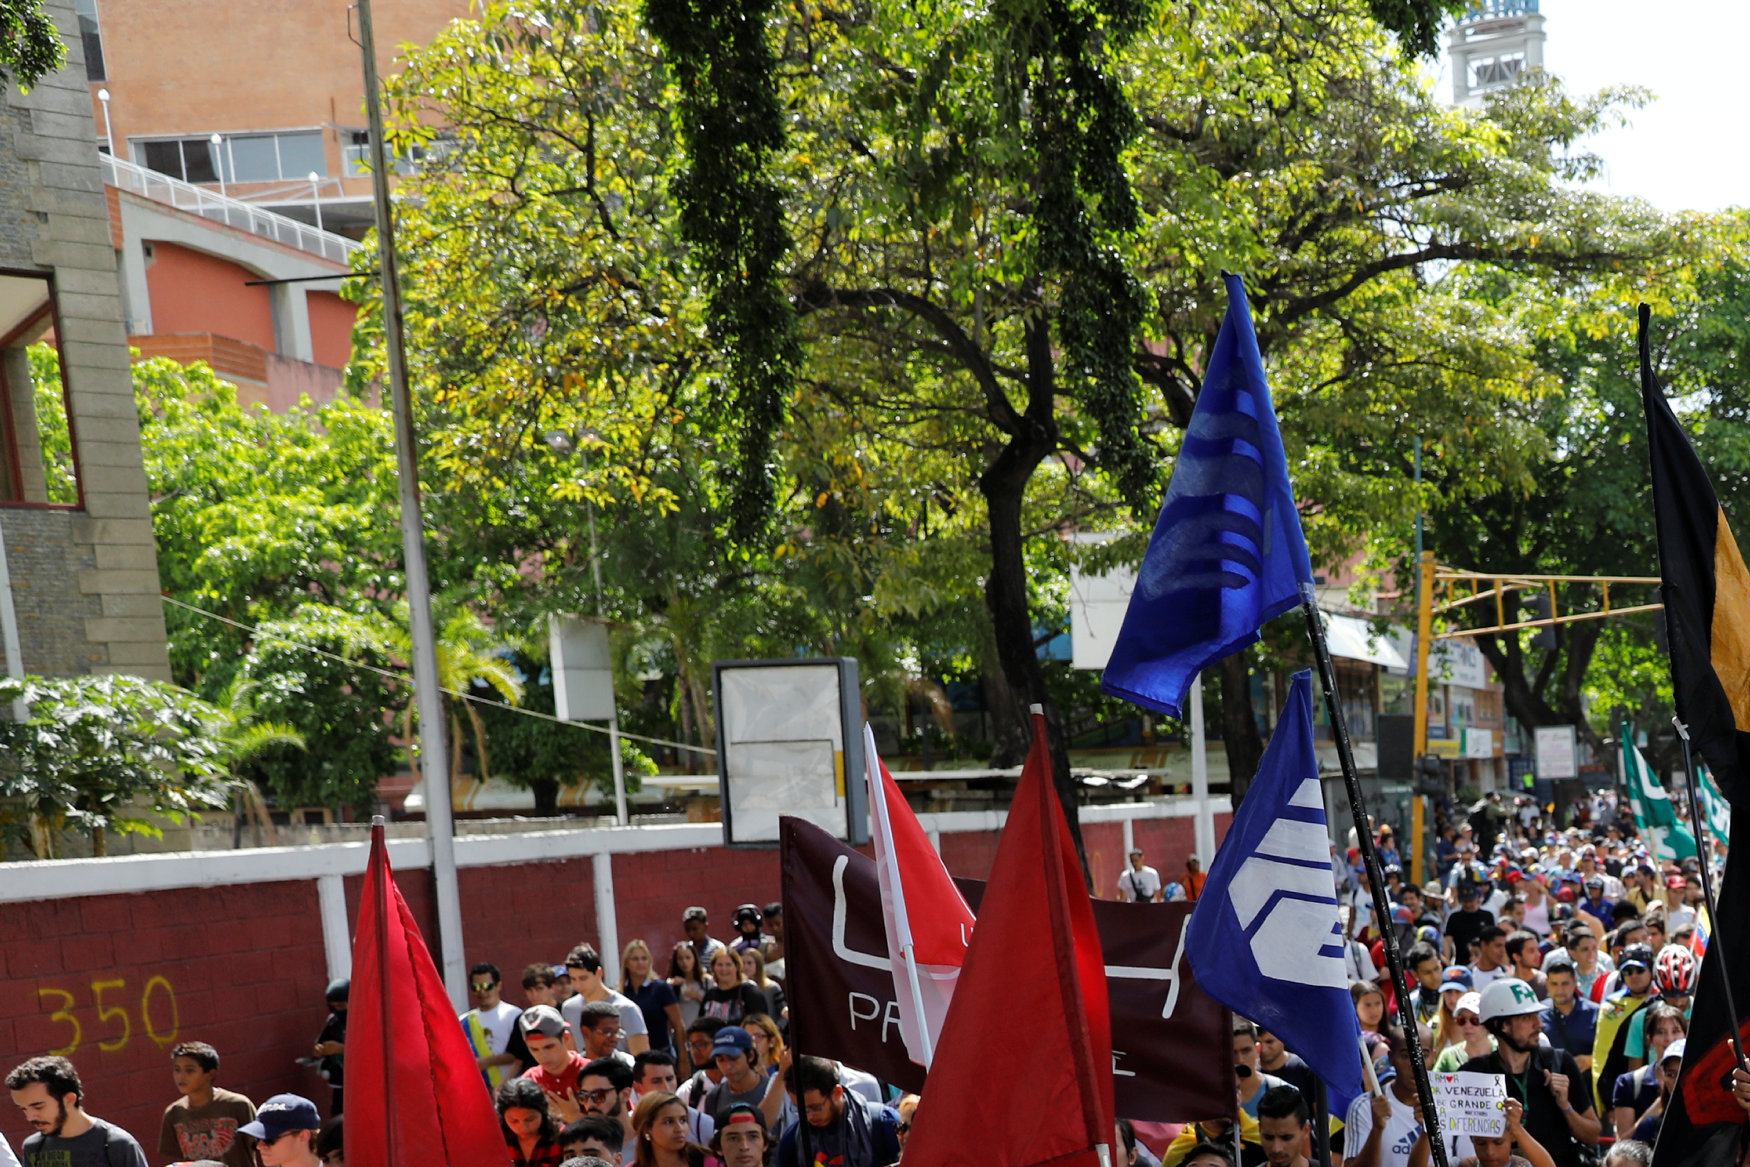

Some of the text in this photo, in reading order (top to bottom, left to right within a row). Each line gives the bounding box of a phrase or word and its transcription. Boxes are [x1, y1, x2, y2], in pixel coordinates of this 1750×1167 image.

[31, 975, 179, 1056] 350
[1445, 1086, 1506, 1098] VENEZUELA
[1450, 1100, 1492, 1110] GRANDE
